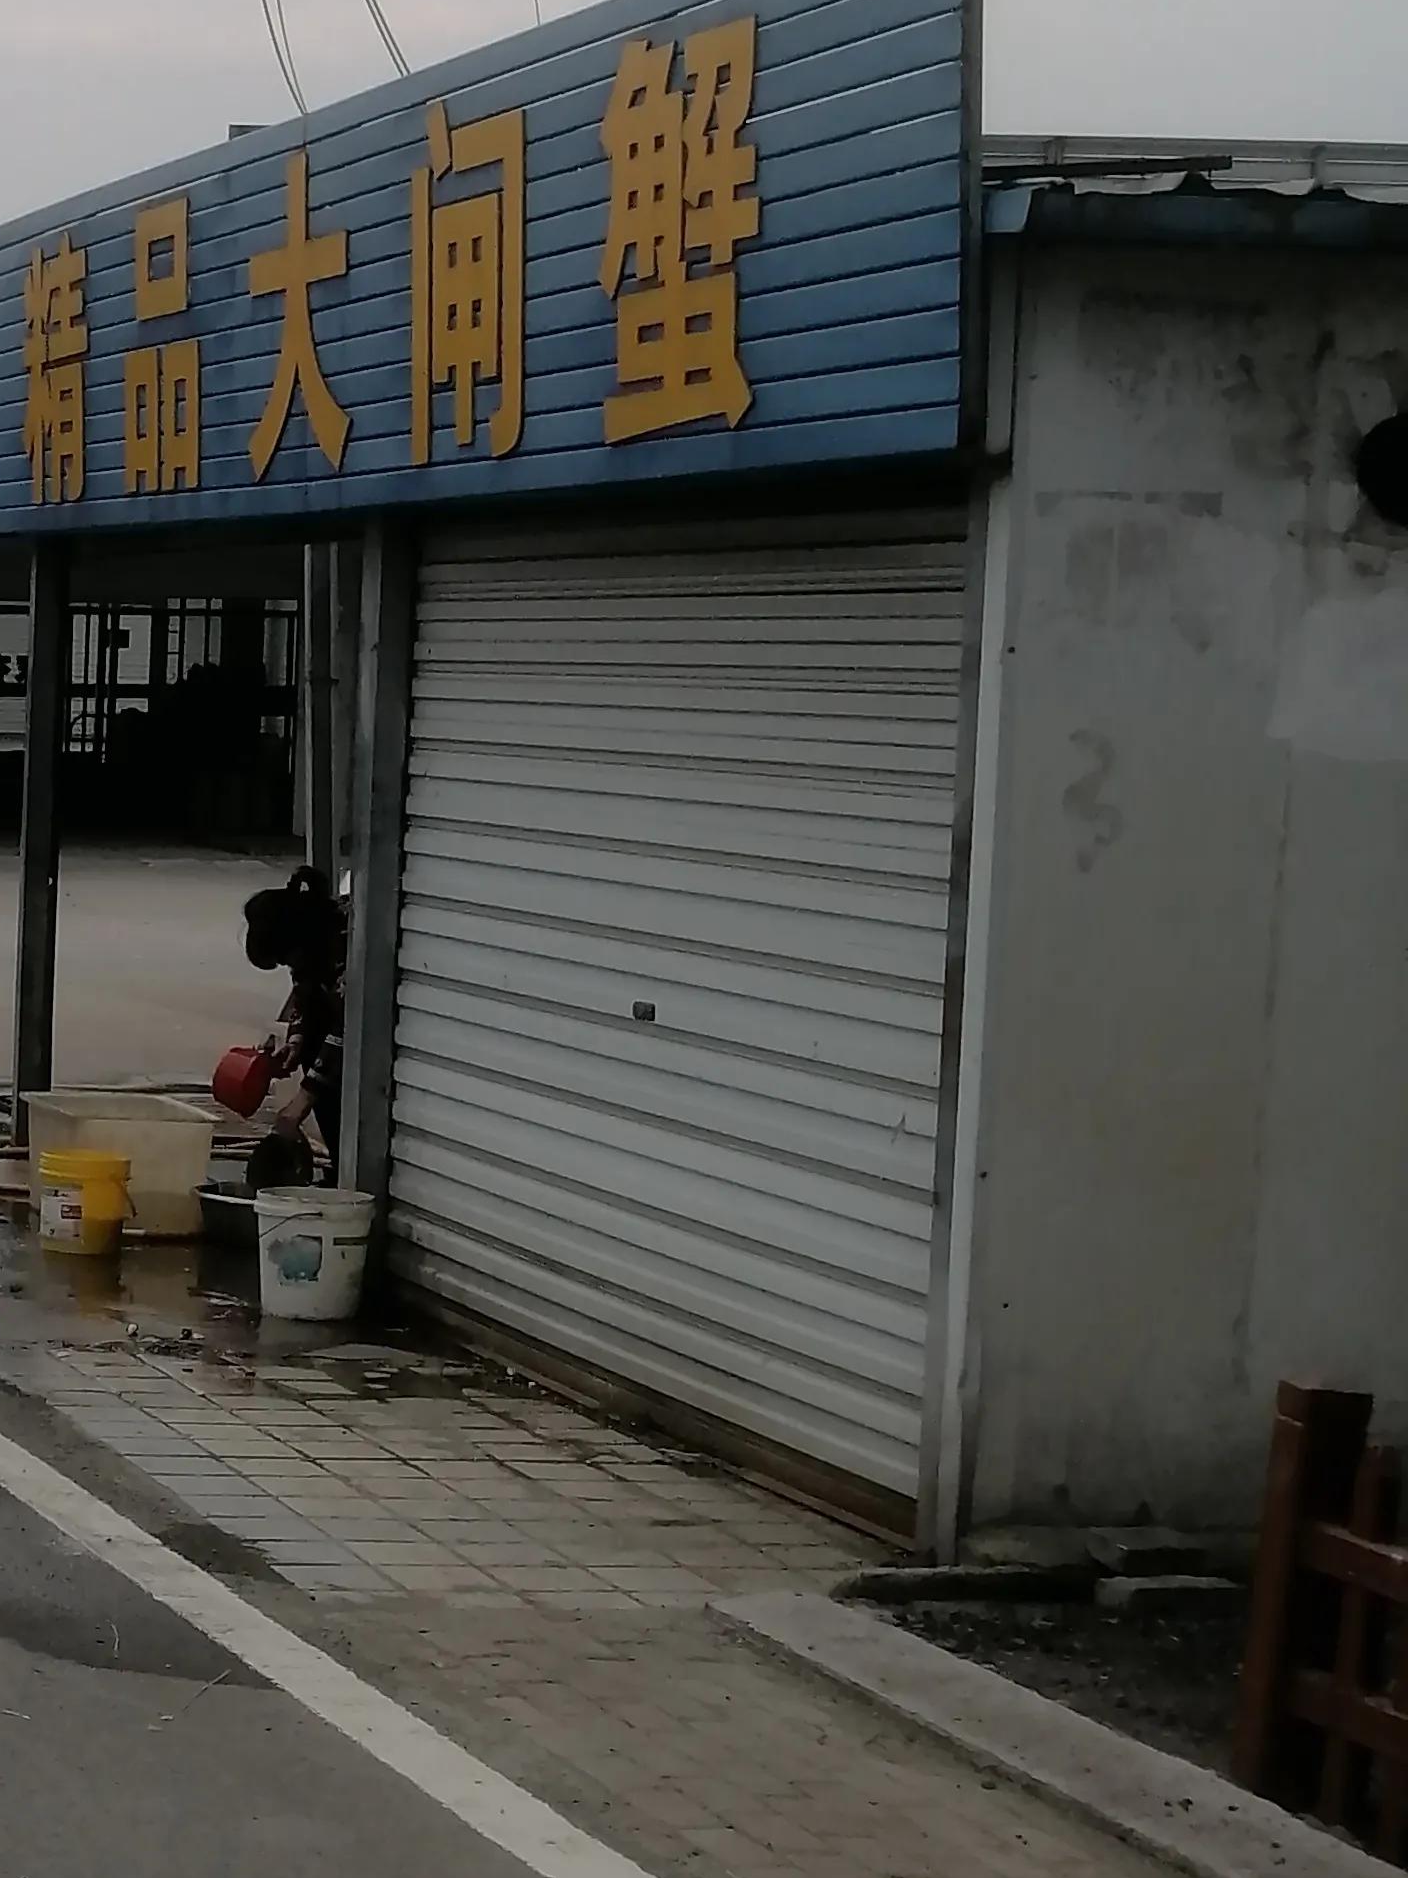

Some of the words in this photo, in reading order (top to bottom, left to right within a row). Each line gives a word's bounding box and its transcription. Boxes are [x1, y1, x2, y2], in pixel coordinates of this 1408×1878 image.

[21, 13, 761, 503] 精品大闸蟹
